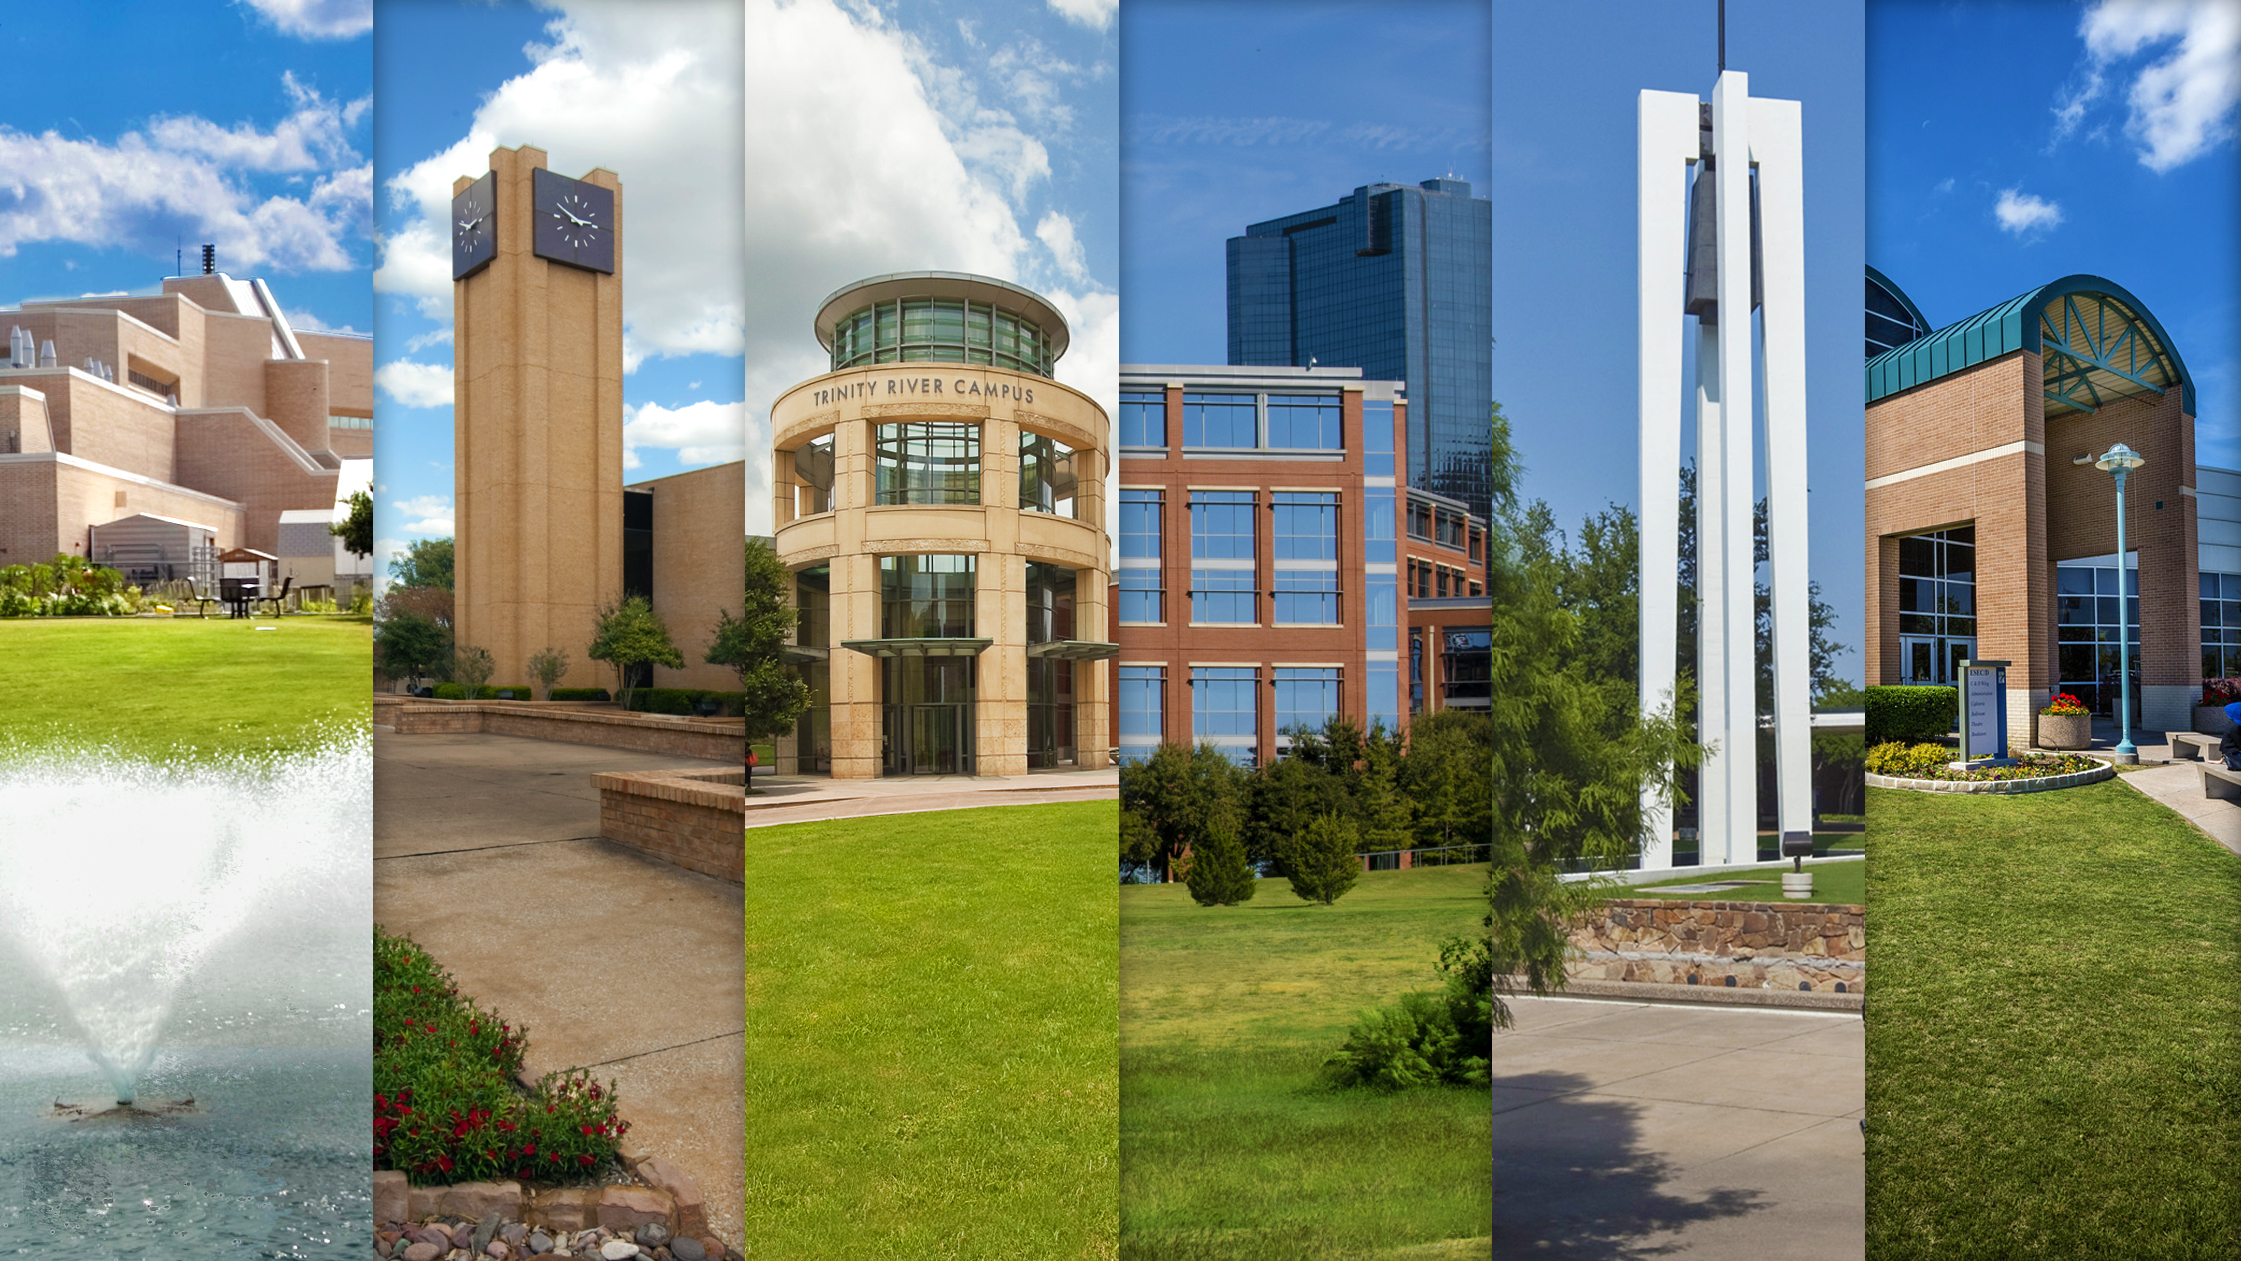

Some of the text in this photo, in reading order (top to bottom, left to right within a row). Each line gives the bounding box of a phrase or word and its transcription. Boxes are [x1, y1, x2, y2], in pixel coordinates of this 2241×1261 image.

[813, 378, 1035, 407] TRINITY RIVER CAMPUS
